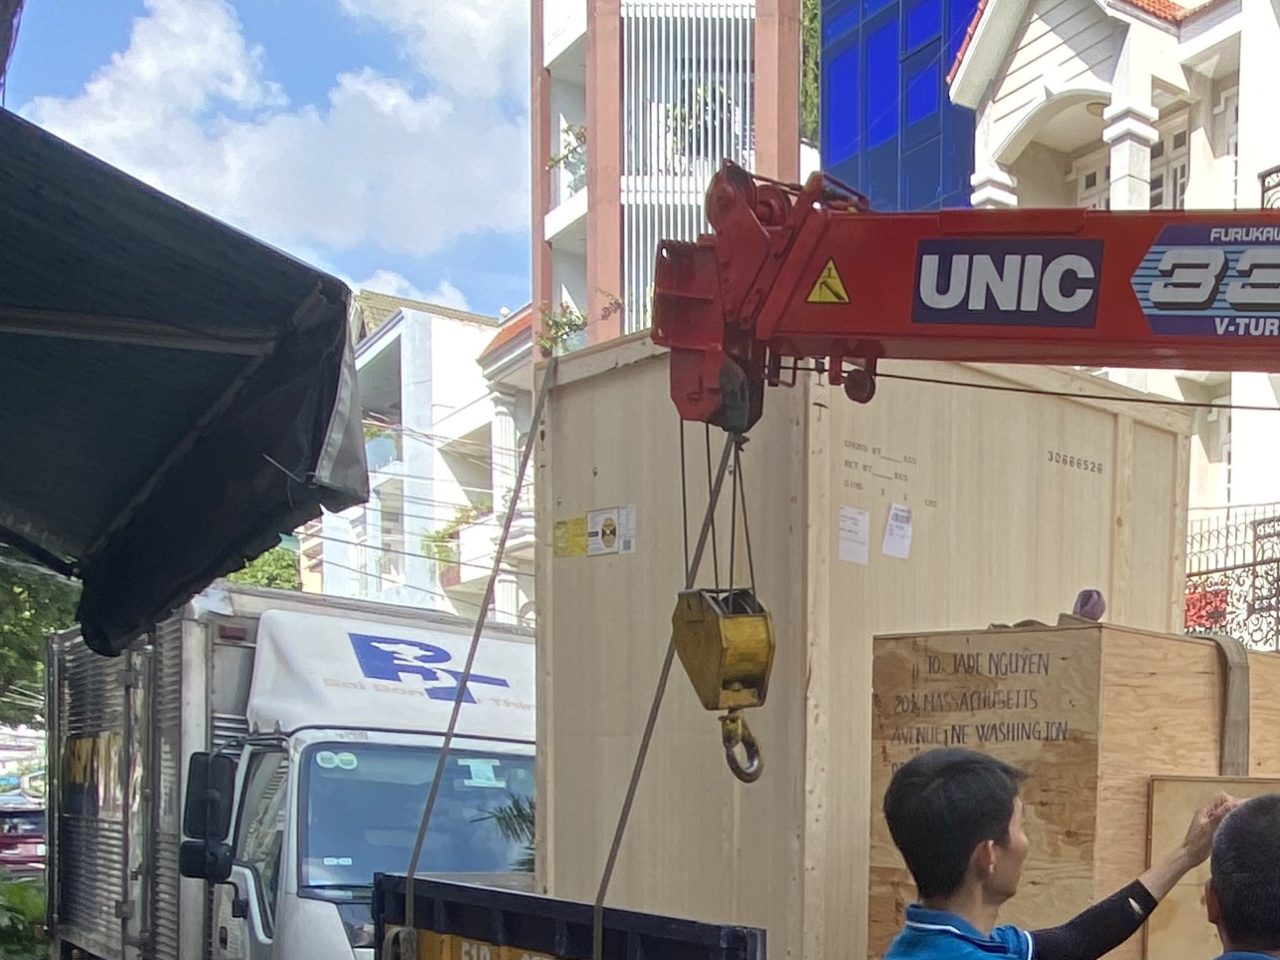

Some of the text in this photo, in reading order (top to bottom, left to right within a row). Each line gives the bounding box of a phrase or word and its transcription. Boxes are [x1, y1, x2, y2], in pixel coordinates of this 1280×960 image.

[919, 254, 1095, 312] UNIC
[988, 652, 1050, 676] NGUYEN
[951, 724, 969, 744] NE
[975, 721, 1068, 742] WASHINGTON
